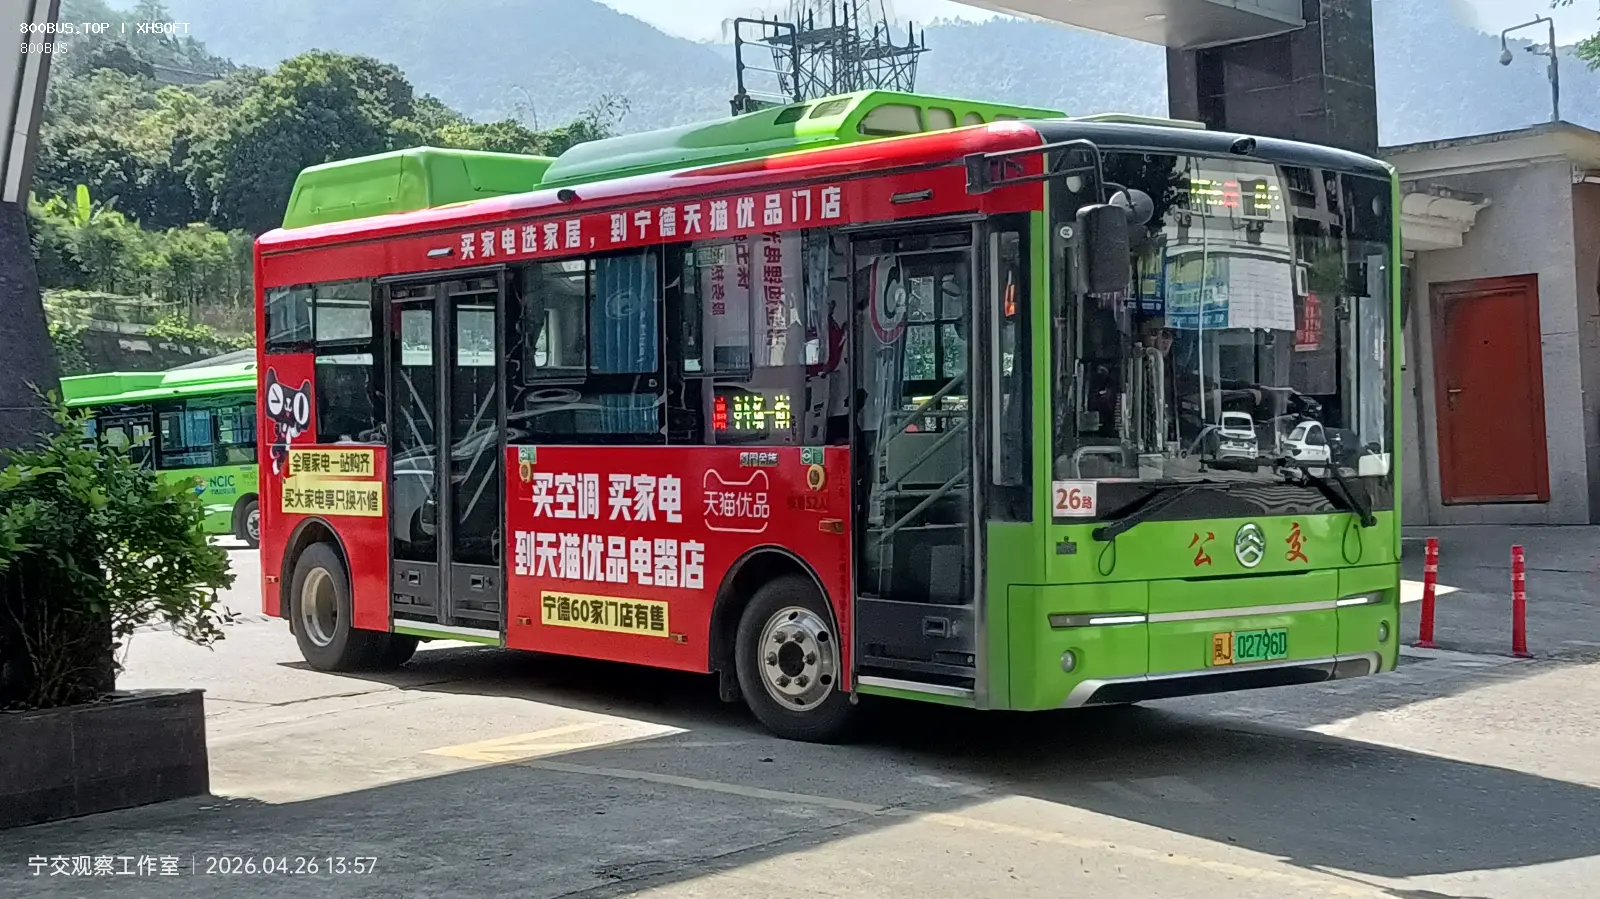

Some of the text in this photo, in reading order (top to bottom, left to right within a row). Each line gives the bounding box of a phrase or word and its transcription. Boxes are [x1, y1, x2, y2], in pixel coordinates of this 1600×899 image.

[292, 452, 370, 474] 全屋家电一站购齐
[209, 474, 236, 487] NCIC
[284, 488, 379, 512] 买大家电享只换不修
[531, 472, 683, 524] 买空调 买家电
[703, 491, 770, 519] 天猫优品
[1055, 487, 1093, 510] 26路
[514, 530, 705, 590] 到天猫优品电器店
[542, 595, 665, 632] 宁德60家门店有售
